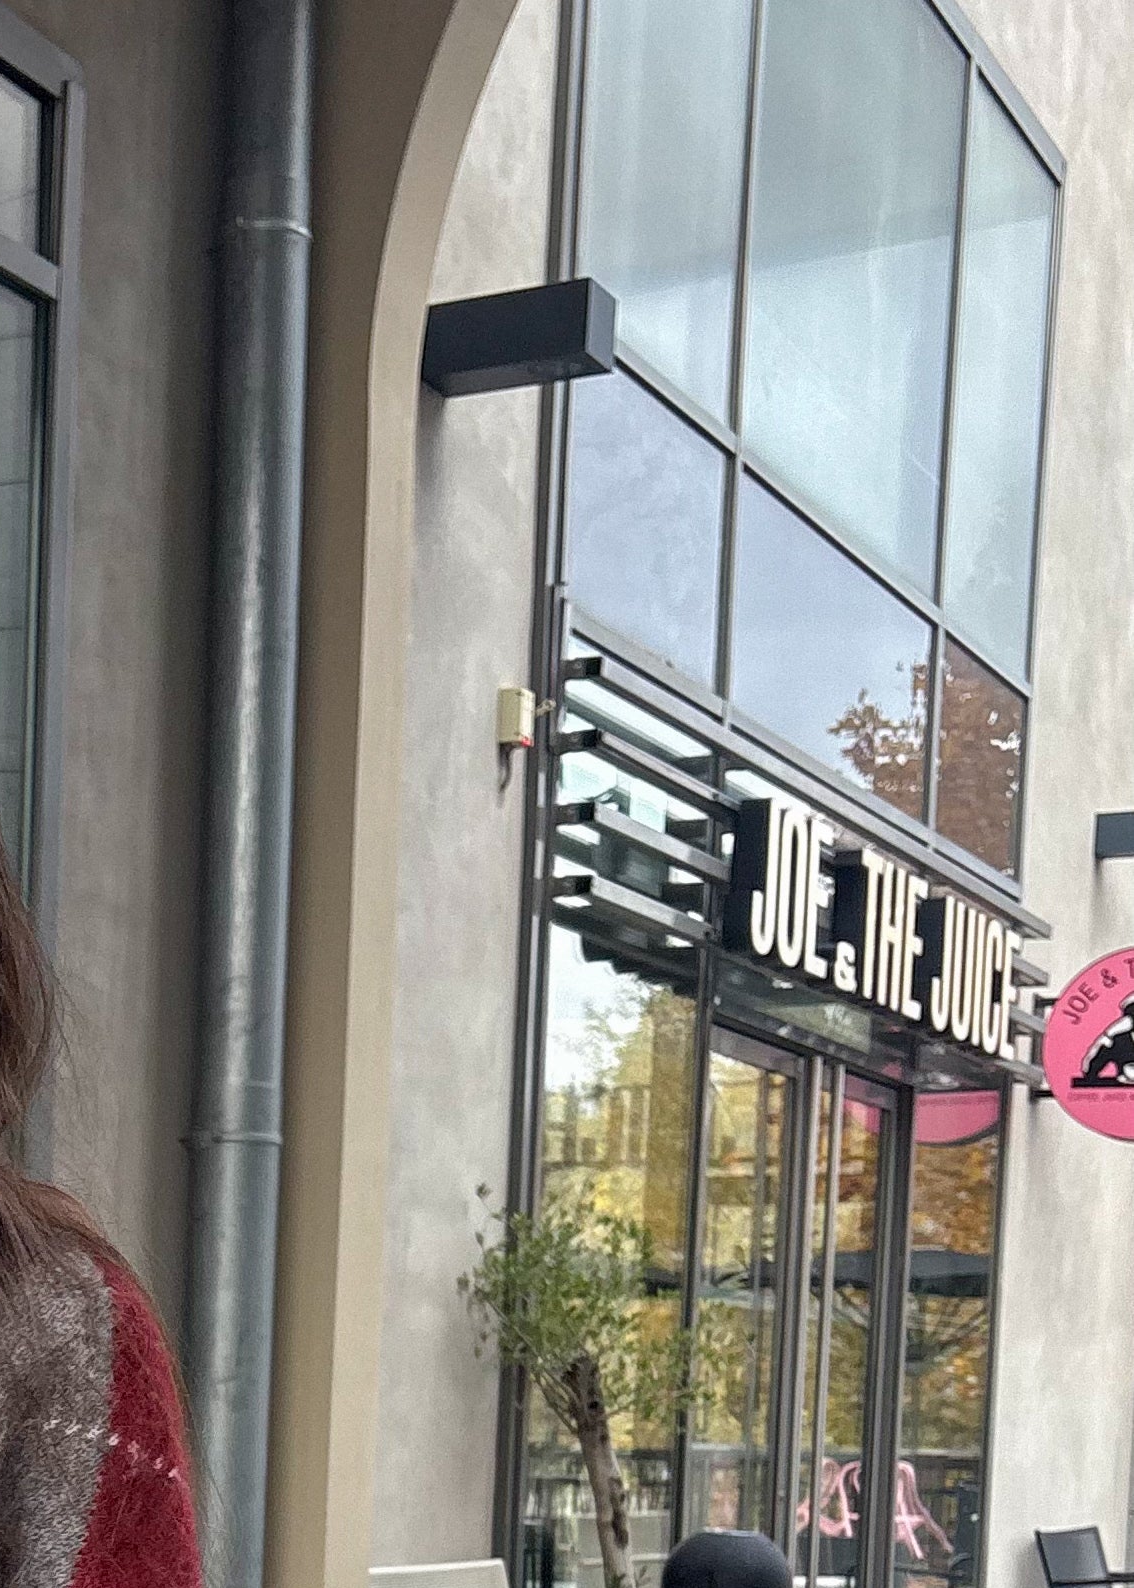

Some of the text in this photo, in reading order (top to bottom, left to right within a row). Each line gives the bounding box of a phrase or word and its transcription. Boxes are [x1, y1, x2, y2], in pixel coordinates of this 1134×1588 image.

[751, 798, 1022, 1061] JOE & THE JUICE
[1062, 981, 1100, 1025] JOE
[1100, 967, 1120, 990] &
